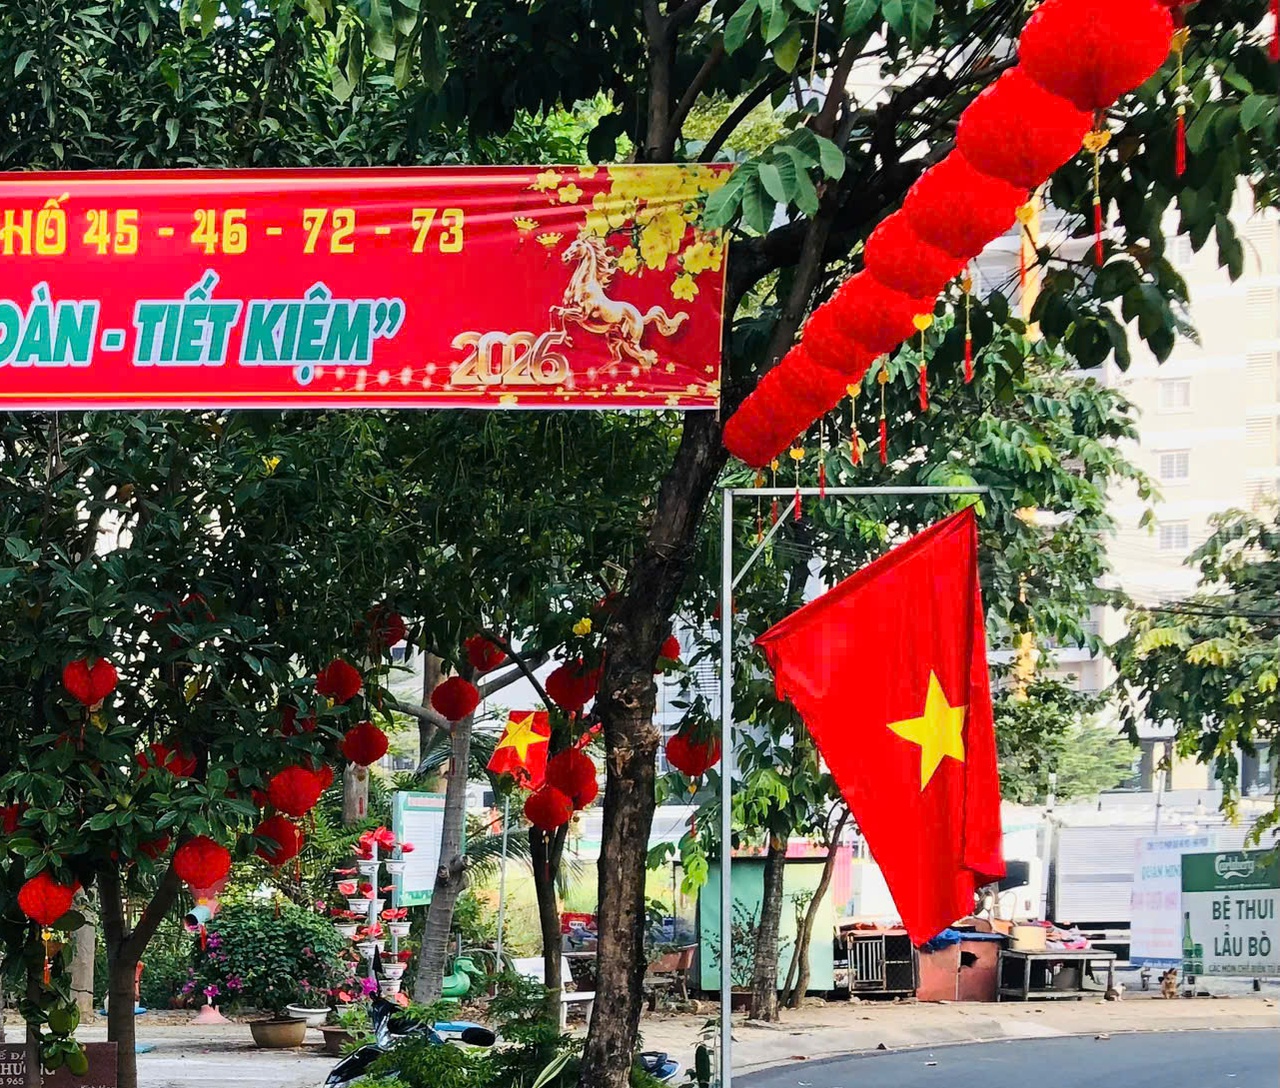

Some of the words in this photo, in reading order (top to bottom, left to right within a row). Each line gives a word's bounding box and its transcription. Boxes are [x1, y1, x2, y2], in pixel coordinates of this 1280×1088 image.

[82, 208, 139, 255] 45
[158, 227, 174, 236] -
[190, 208, 248, 254] 46
[266, 227, 282, 235] -
[302, 208, 356, 254] 72
[376, 227, 391, 235] -
[411, 208, 465, 254] 73
[101, 329, 125, 351] -
[133, 269, 243, 367] TIẾT
[240, 282, 406, 385] KIỆM”
[450, 331, 570, 385] 2026
[1212, 895, 1231, 920] BÊ
[1236, 899, 1274, 920] THUI
[1248, 931, 1272, 957] BÒ
[6, 1077, 24, 1085] 965
